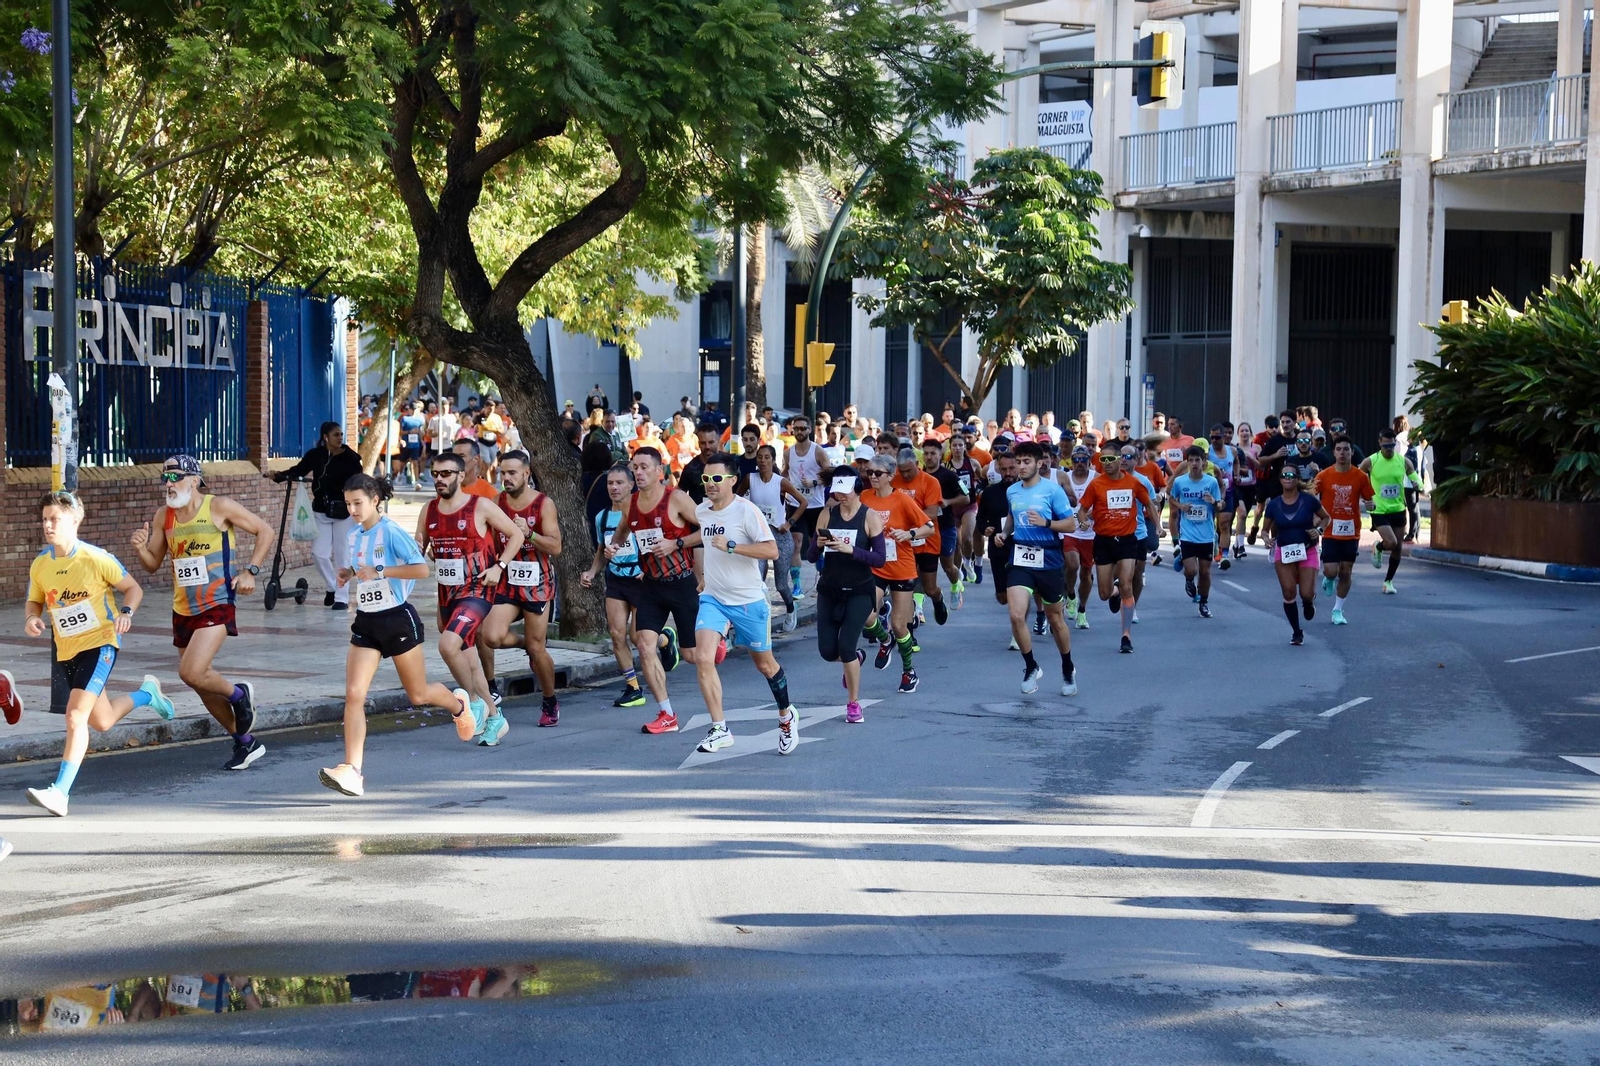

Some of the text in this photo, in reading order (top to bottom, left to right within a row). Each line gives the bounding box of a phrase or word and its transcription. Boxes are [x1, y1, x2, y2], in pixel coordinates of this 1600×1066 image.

[1038, 109, 1085, 124] CORNER VIP
[1038, 123, 1084, 137] MALAGUISTA
[1183, 491, 1204, 500] nerj
[703, 524, 726, 537] nike
[187, 539, 211, 551] Álora
[1021, 552, 1036, 561] 40
[1284, 549, 1302, 558] 242
[178, 566, 200, 578] 281
[438, 568, 457, 577] 986
[511, 569, 533, 579] 787
[59, 588, 90, 601] Álora
[360, 590, 383, 603] 938
[59, 612, 88, 629] 299
